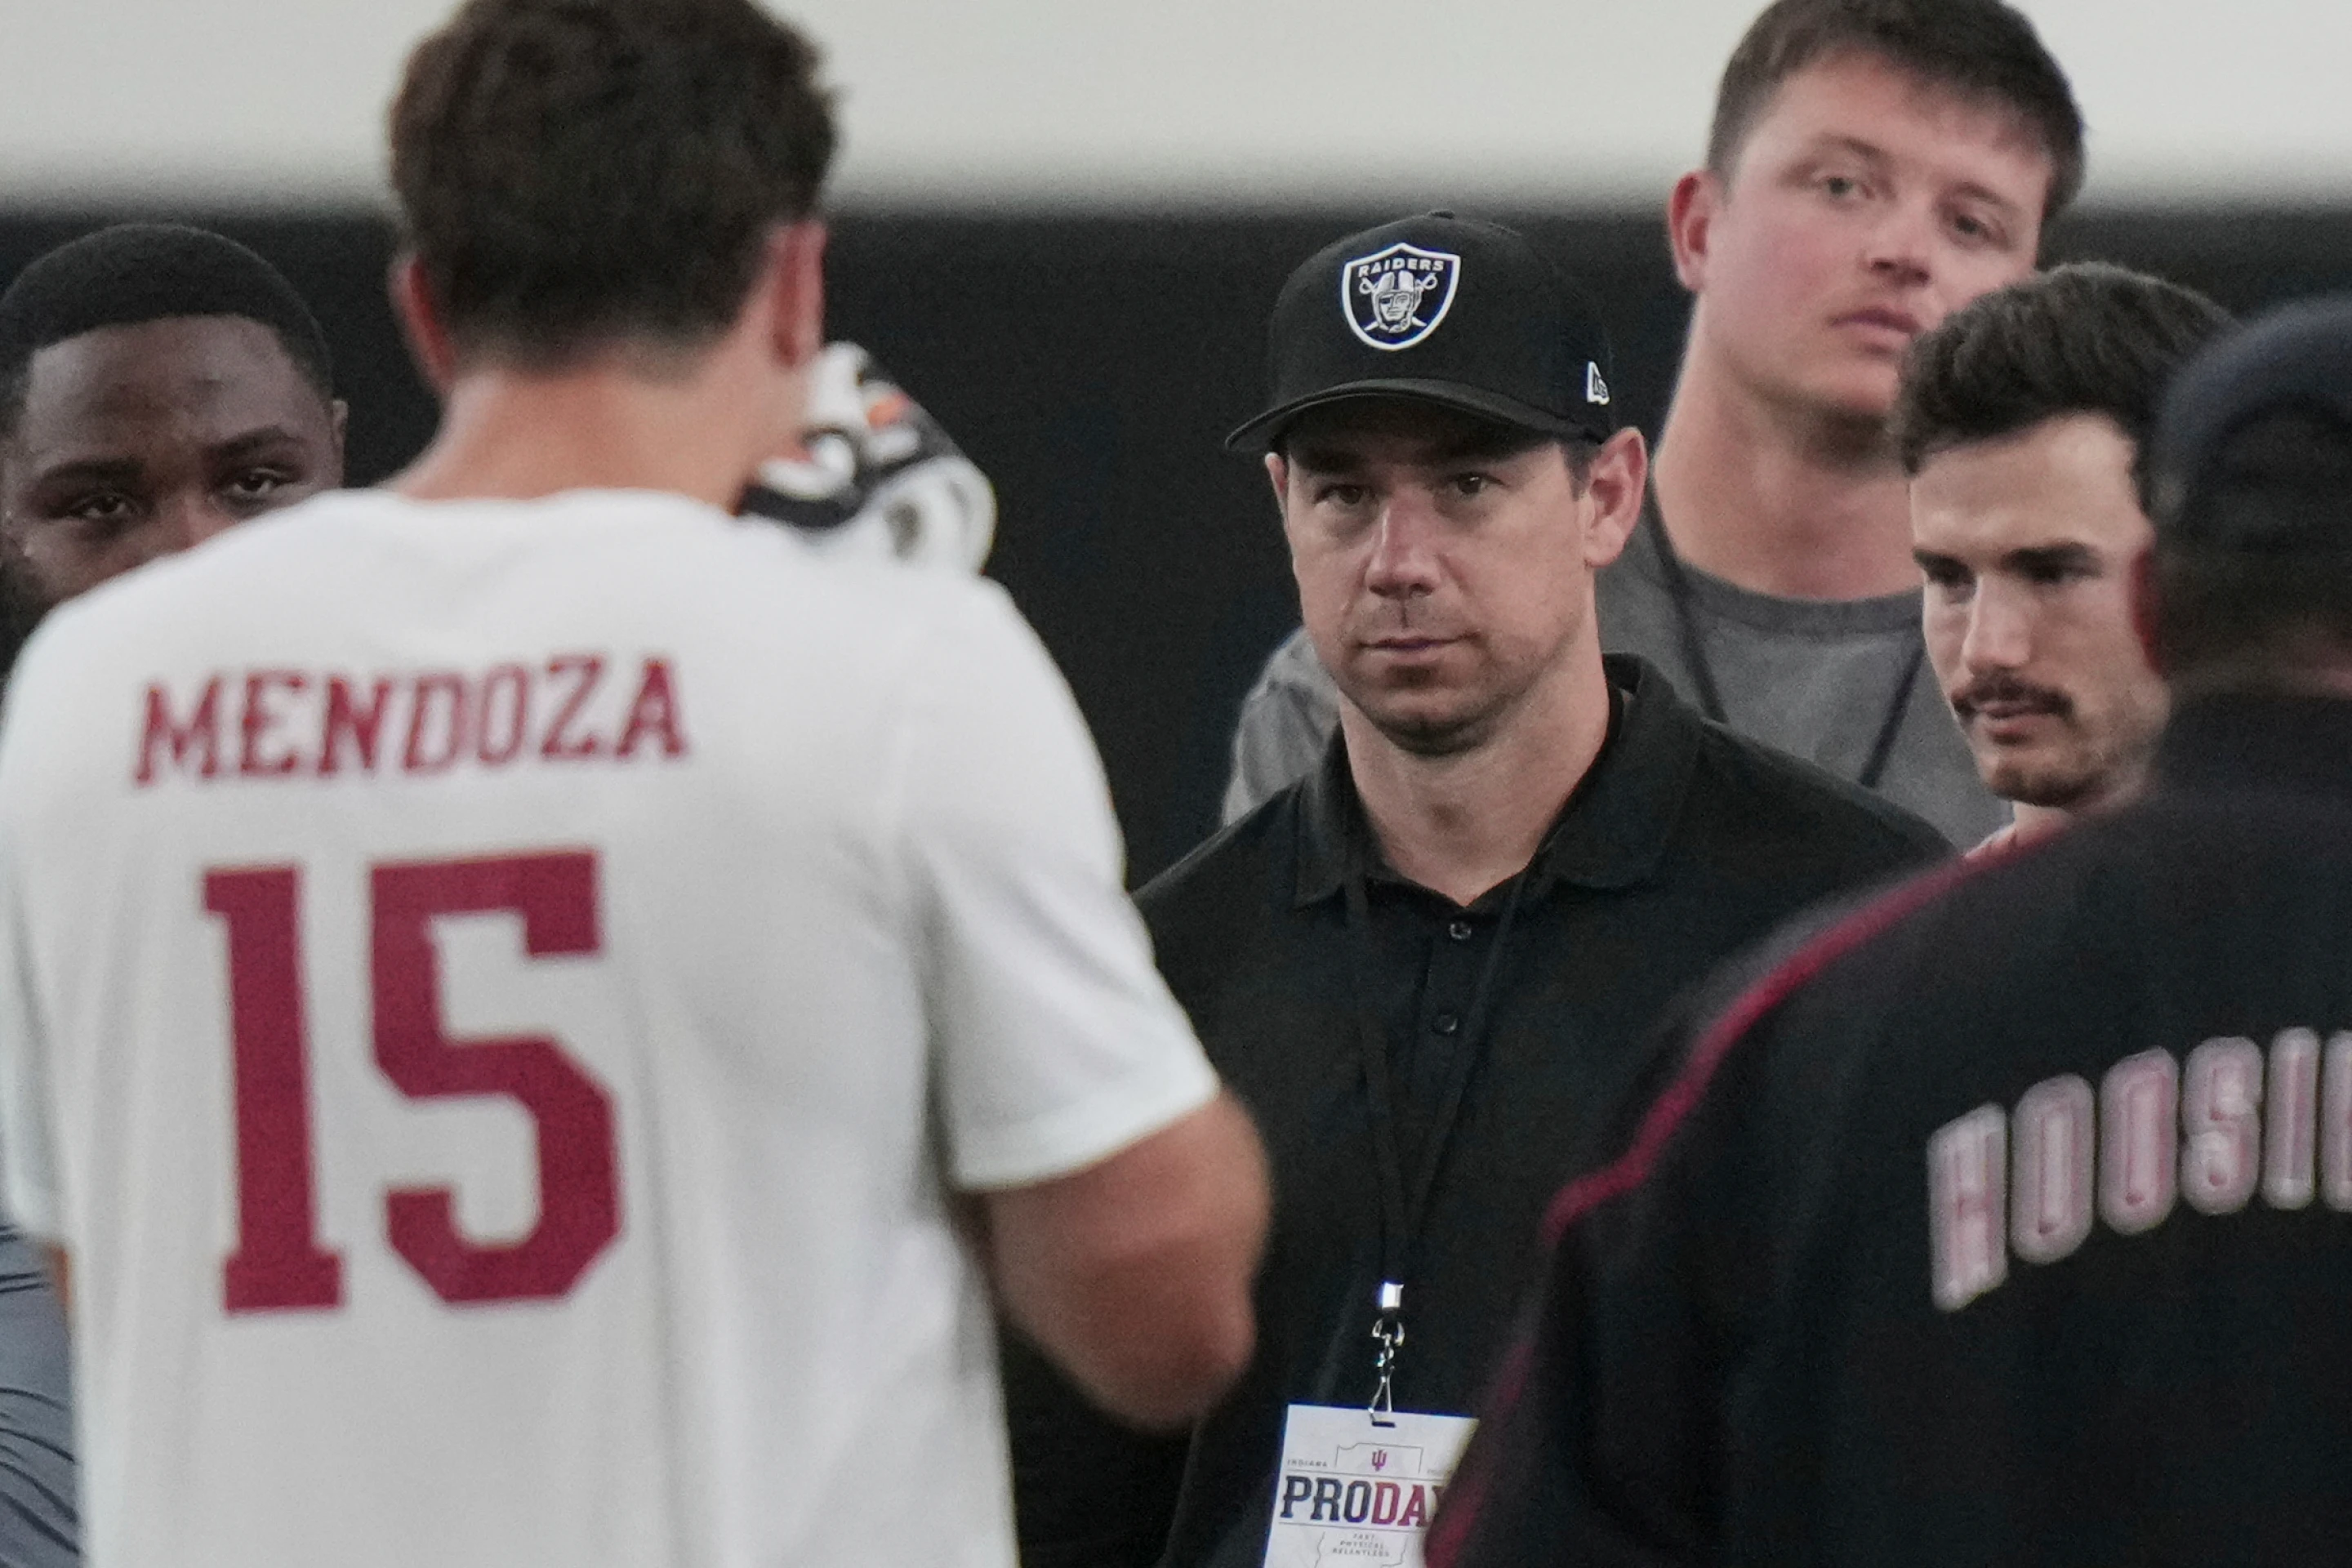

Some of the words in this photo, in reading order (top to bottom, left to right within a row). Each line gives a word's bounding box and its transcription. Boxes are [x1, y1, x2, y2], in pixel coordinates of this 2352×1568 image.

[1358, 257, 1444, 278] RAIDERS
[132, 655, 688, 786] MENDOZA
[203, 848, 621, 1315] 15
